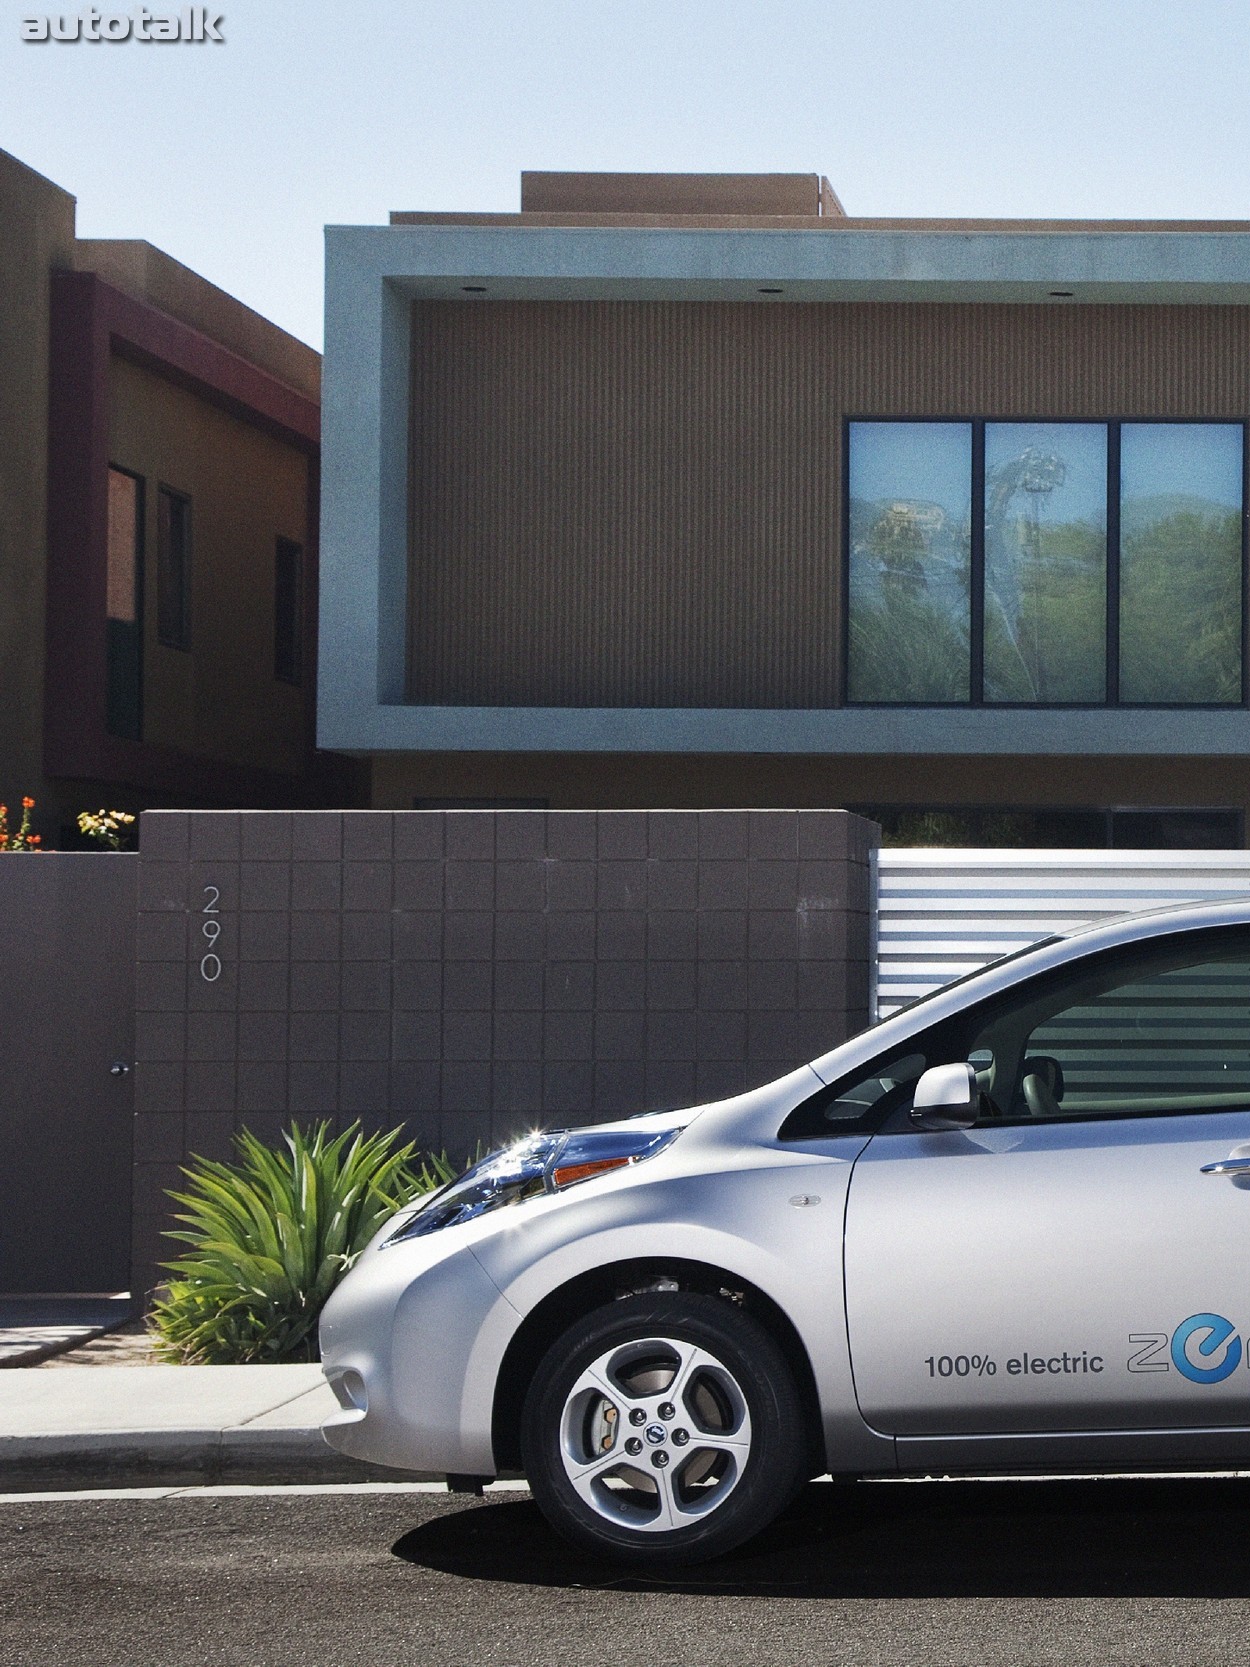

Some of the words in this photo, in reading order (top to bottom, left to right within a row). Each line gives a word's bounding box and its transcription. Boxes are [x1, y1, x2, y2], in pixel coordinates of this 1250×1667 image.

[201, 886, 221, 981] 290
[924, 1355, 997, 1377] 100%
[1006, 1351, 1104, 1375] electric
